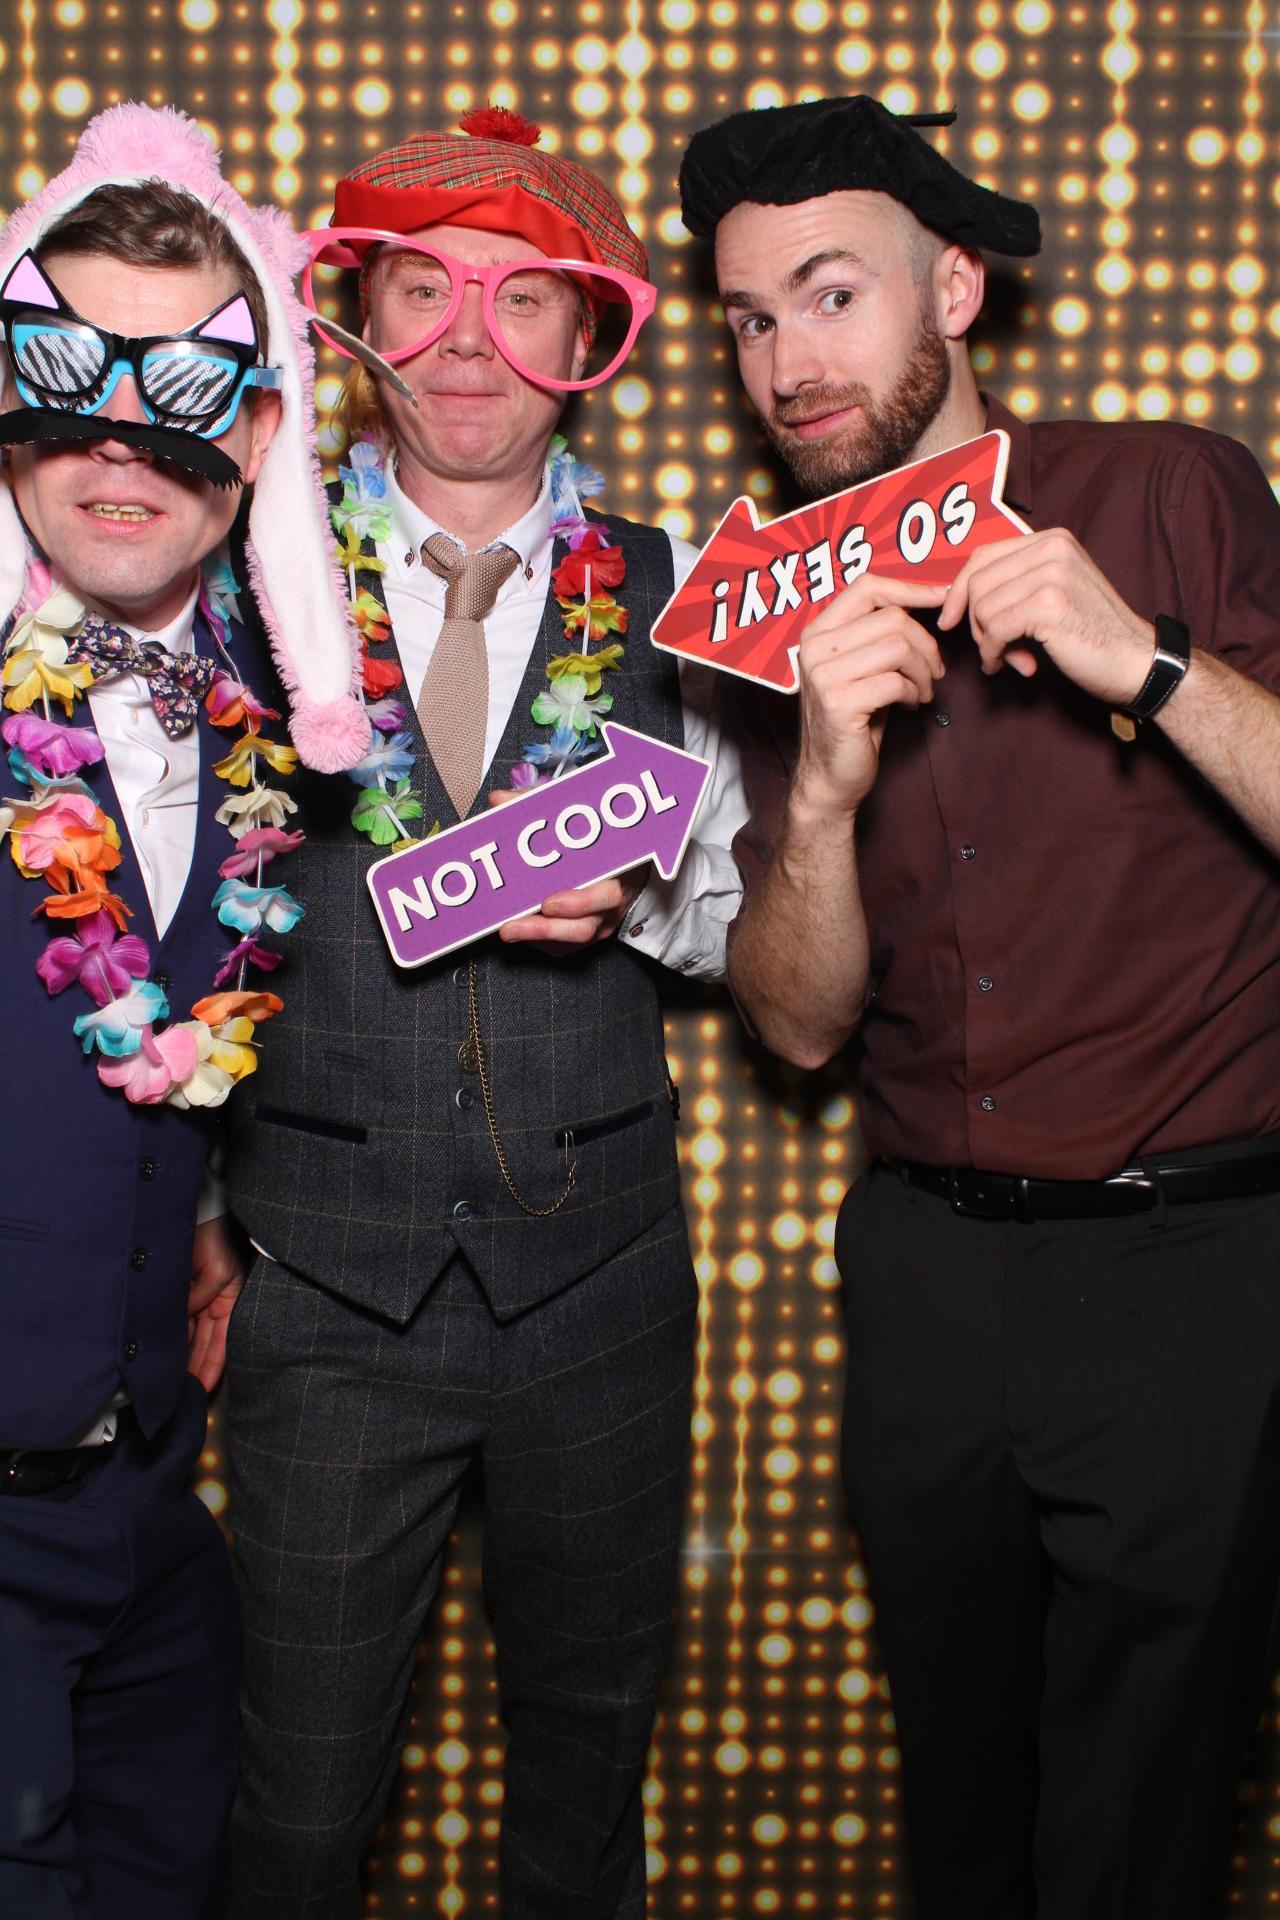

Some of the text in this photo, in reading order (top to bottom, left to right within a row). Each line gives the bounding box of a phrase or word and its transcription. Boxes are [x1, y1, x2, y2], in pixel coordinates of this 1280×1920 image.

[709, 481, 977, 642] SO SEXY!
[387, 770, 679, 932] NOT COOL
